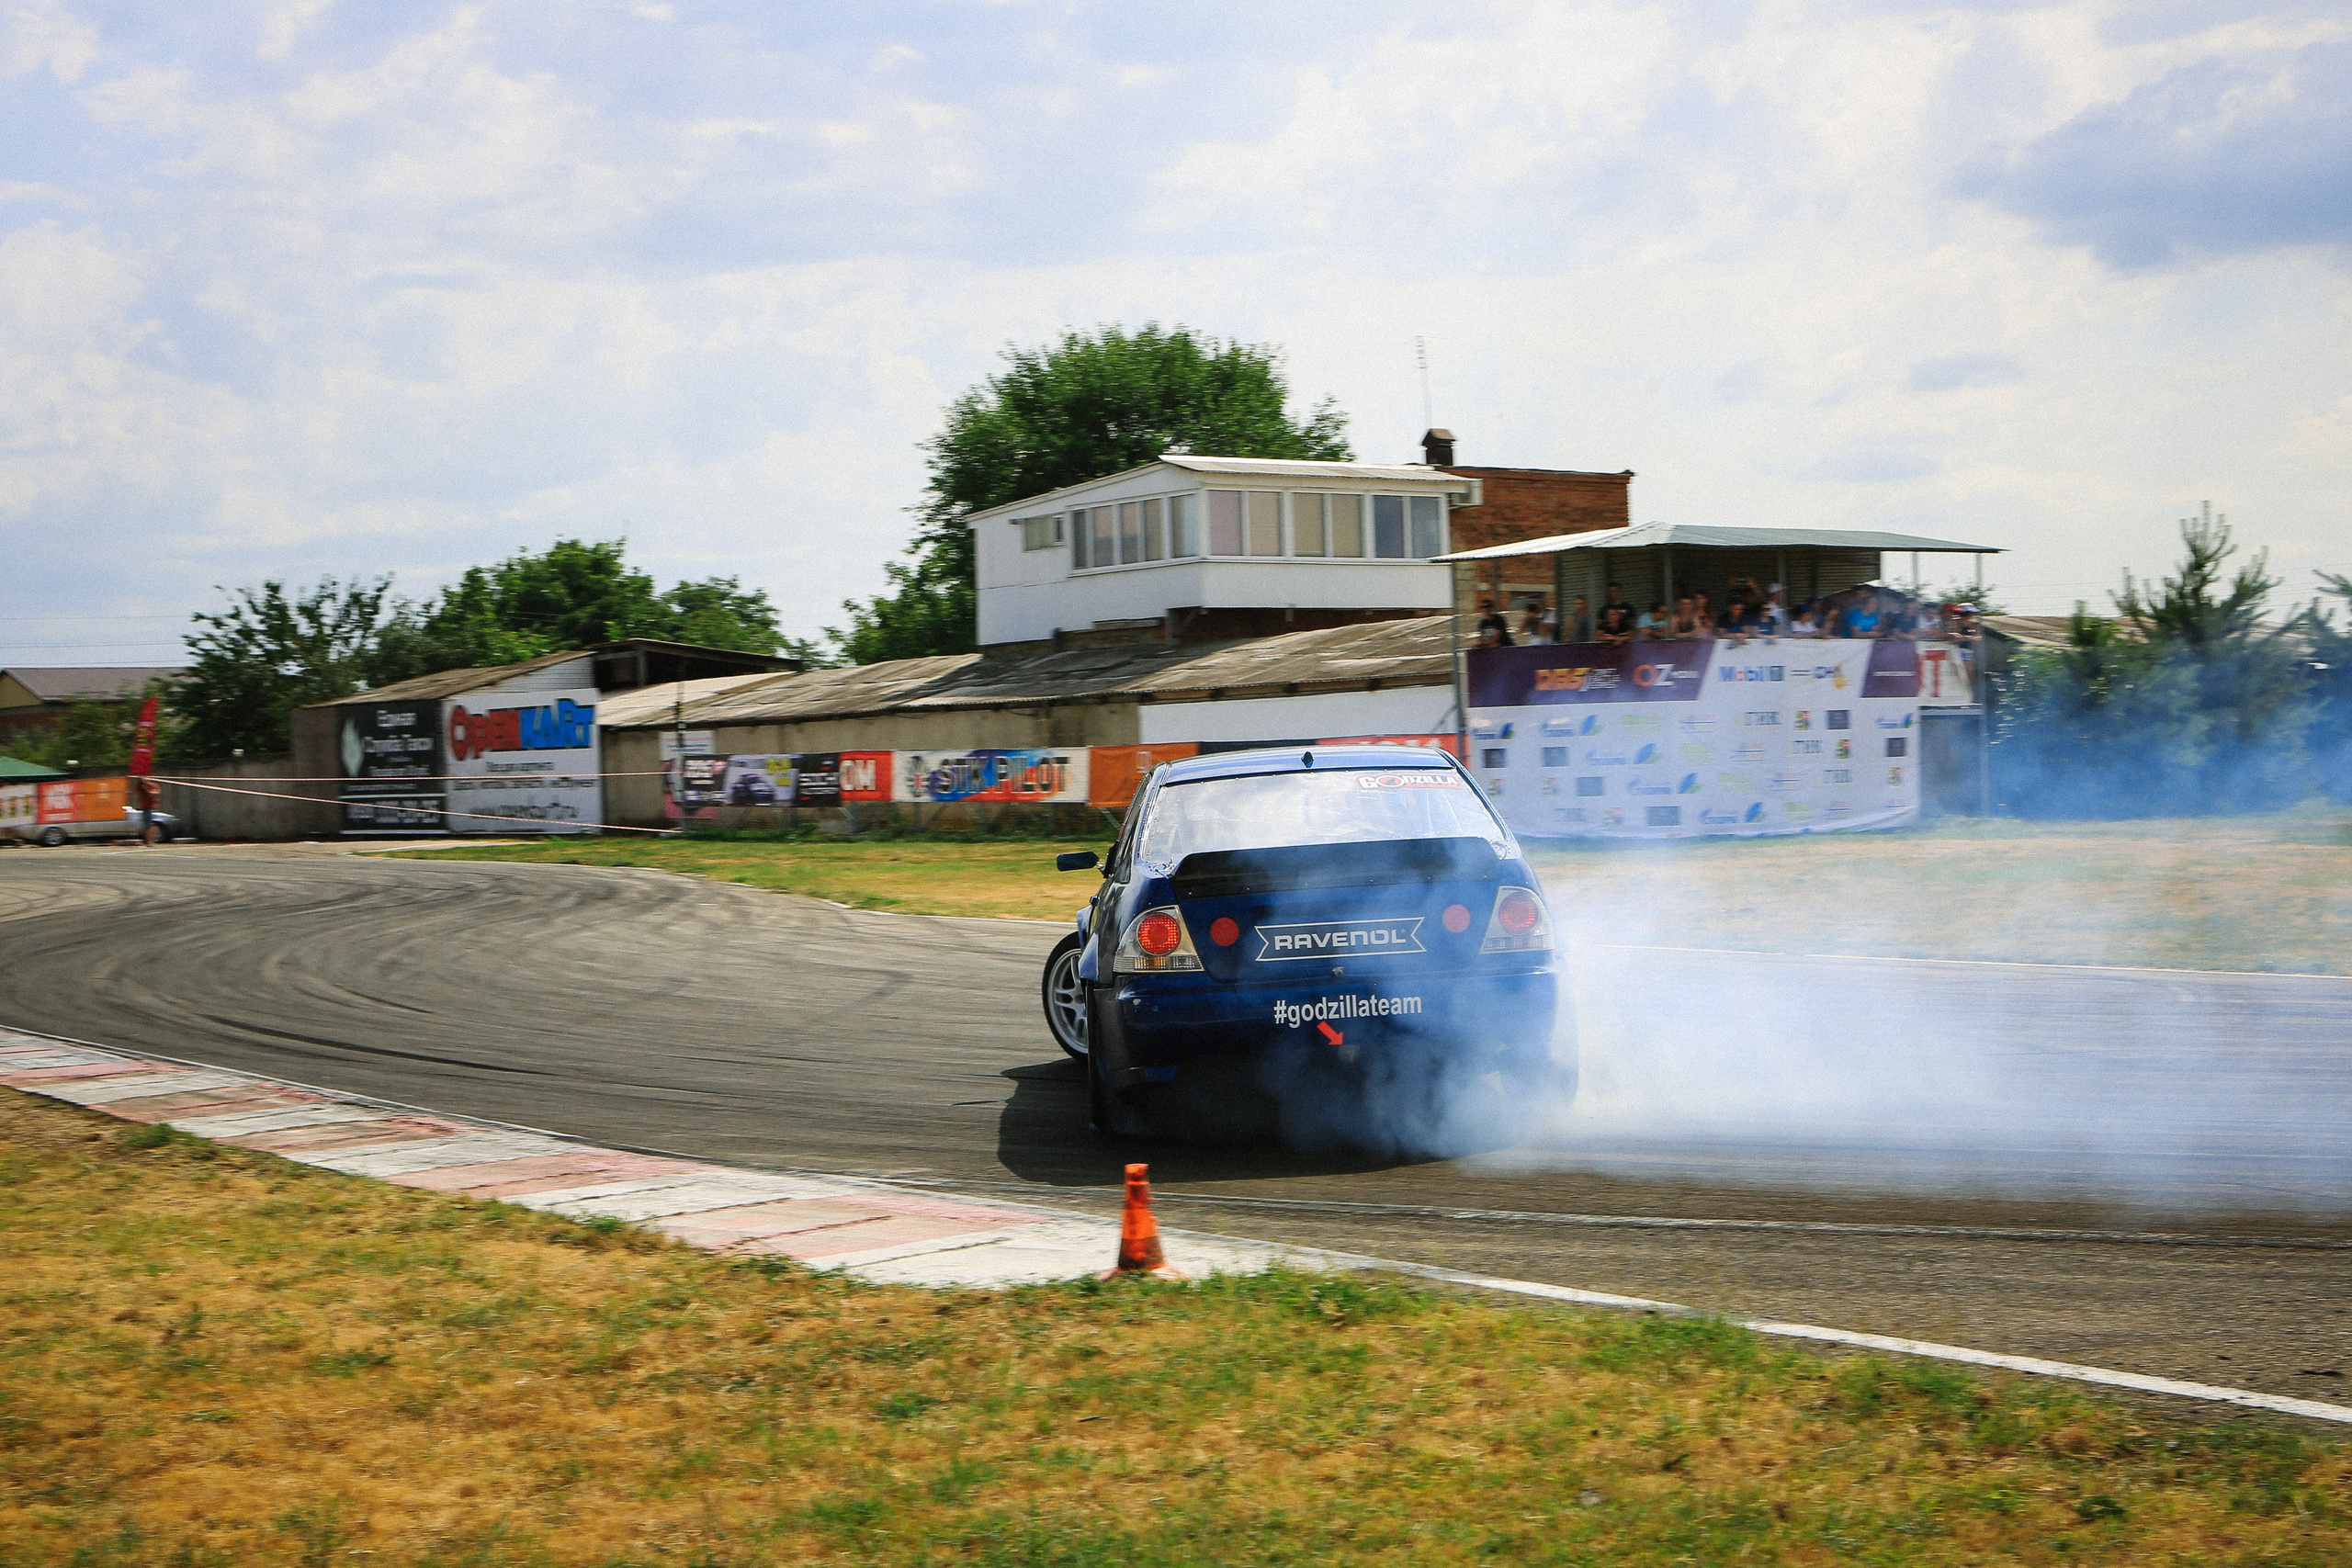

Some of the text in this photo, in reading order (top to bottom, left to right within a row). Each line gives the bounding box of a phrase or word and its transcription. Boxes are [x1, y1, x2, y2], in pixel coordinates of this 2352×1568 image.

[995, 755, 1070, 794] PILOT
[1274, 928, 1407, 951] RAVENOL
[1273, 993, 1422, 1029] #godzillateam
